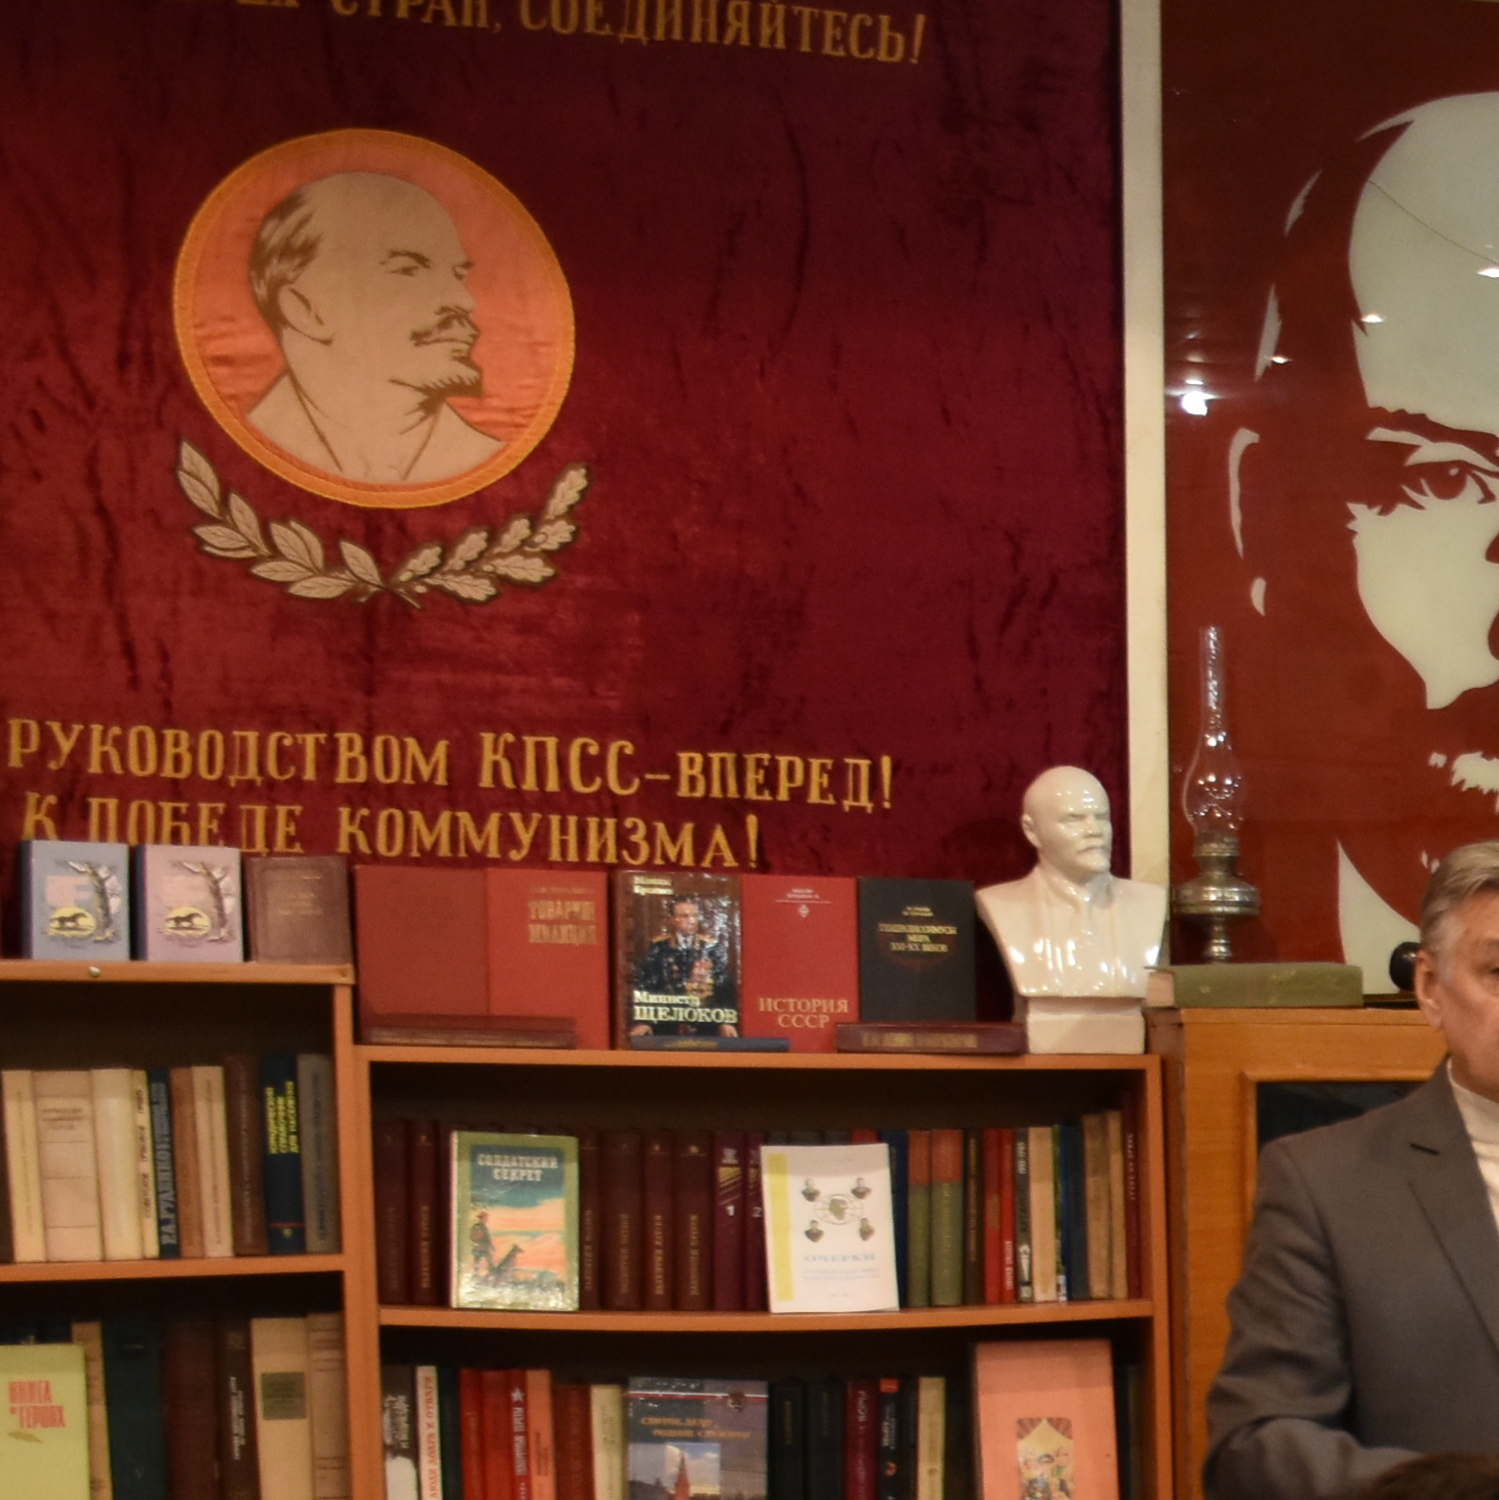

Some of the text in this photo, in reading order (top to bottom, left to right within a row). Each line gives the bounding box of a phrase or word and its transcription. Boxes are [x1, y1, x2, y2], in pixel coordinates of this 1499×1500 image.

[7, 718, 450, 787] РУКОВОДСТВОМ
[22, 791, 759, 868] К ПОБЕДЕ КОММУНИЗМА!
[759, 997, 849, 1013] ИСТОРИЯ
[633, 1005, 739, 1025] ЩЕЛОКОВ
[777, 1013, 830, 1029] СССР
[477, 1152, 559, 1169] СОЛДАТСКИЙ
[493, 1167, 543, 1183] СЕКРЕТ
